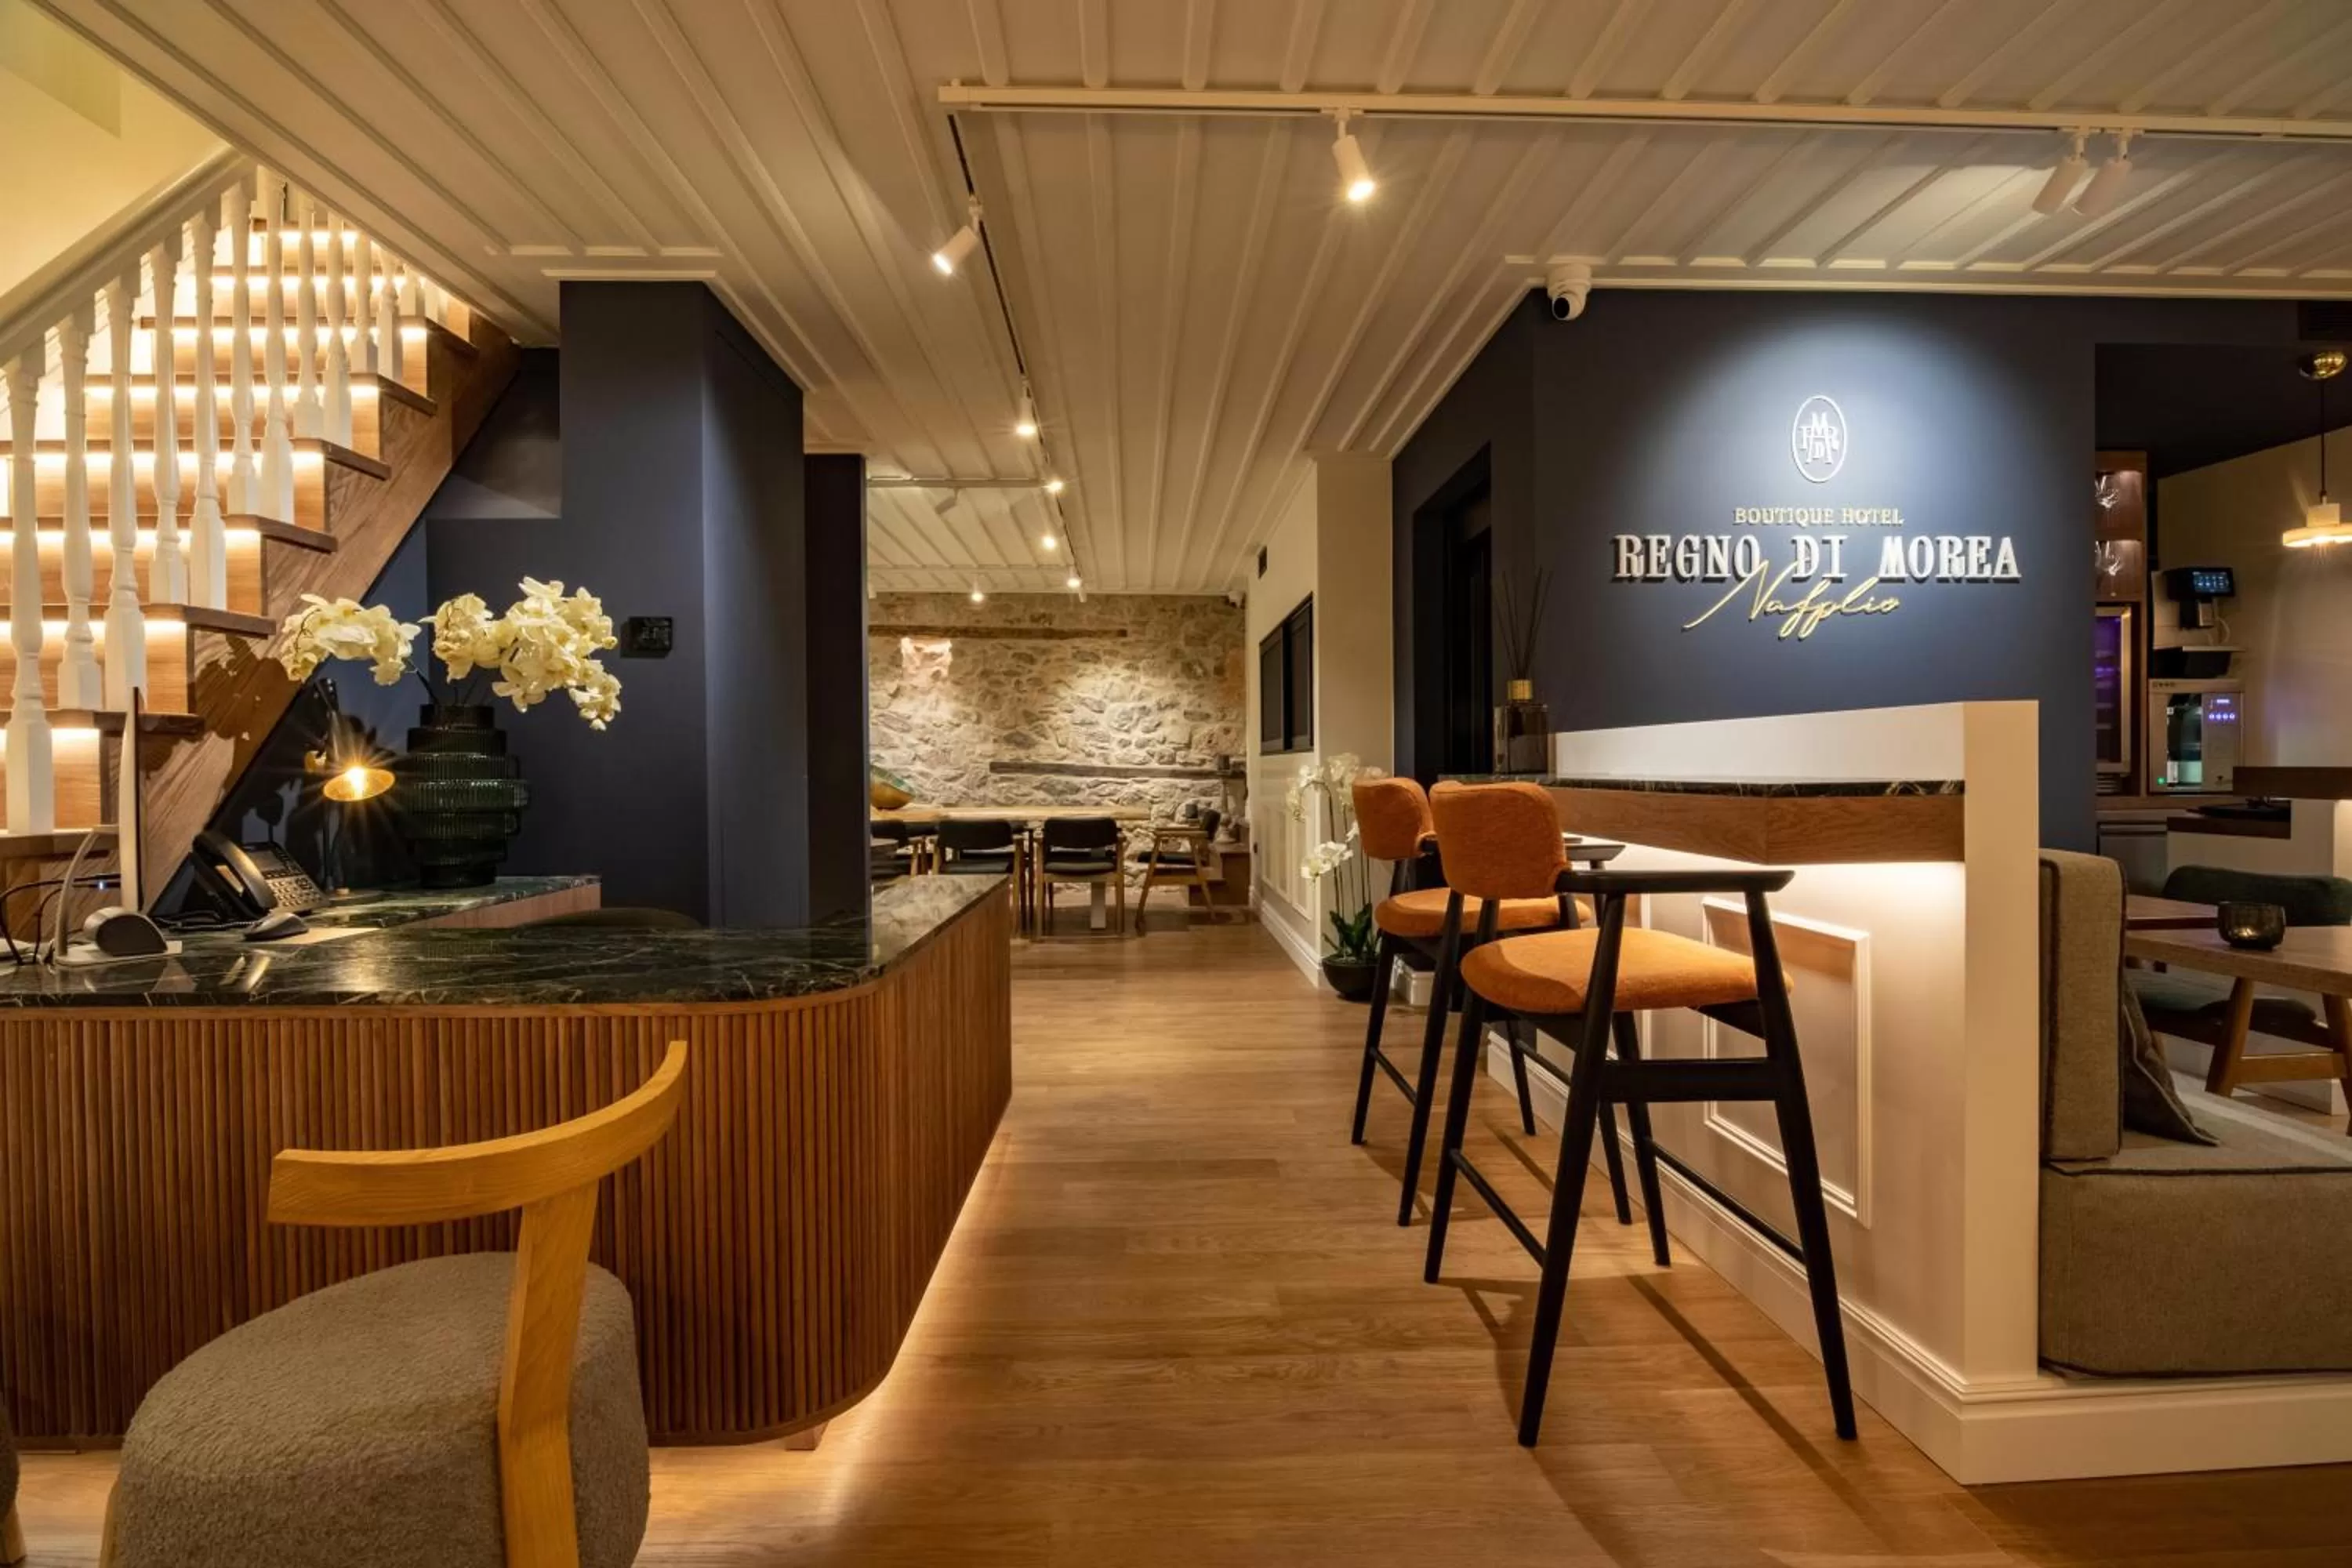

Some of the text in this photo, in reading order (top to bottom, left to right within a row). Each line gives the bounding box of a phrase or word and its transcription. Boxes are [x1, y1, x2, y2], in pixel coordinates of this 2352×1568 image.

[1733, 507, 1905, 527] BOUTIQUE HOTEL
[1613, 534, 2022, 579] REGNO DI MOREA
